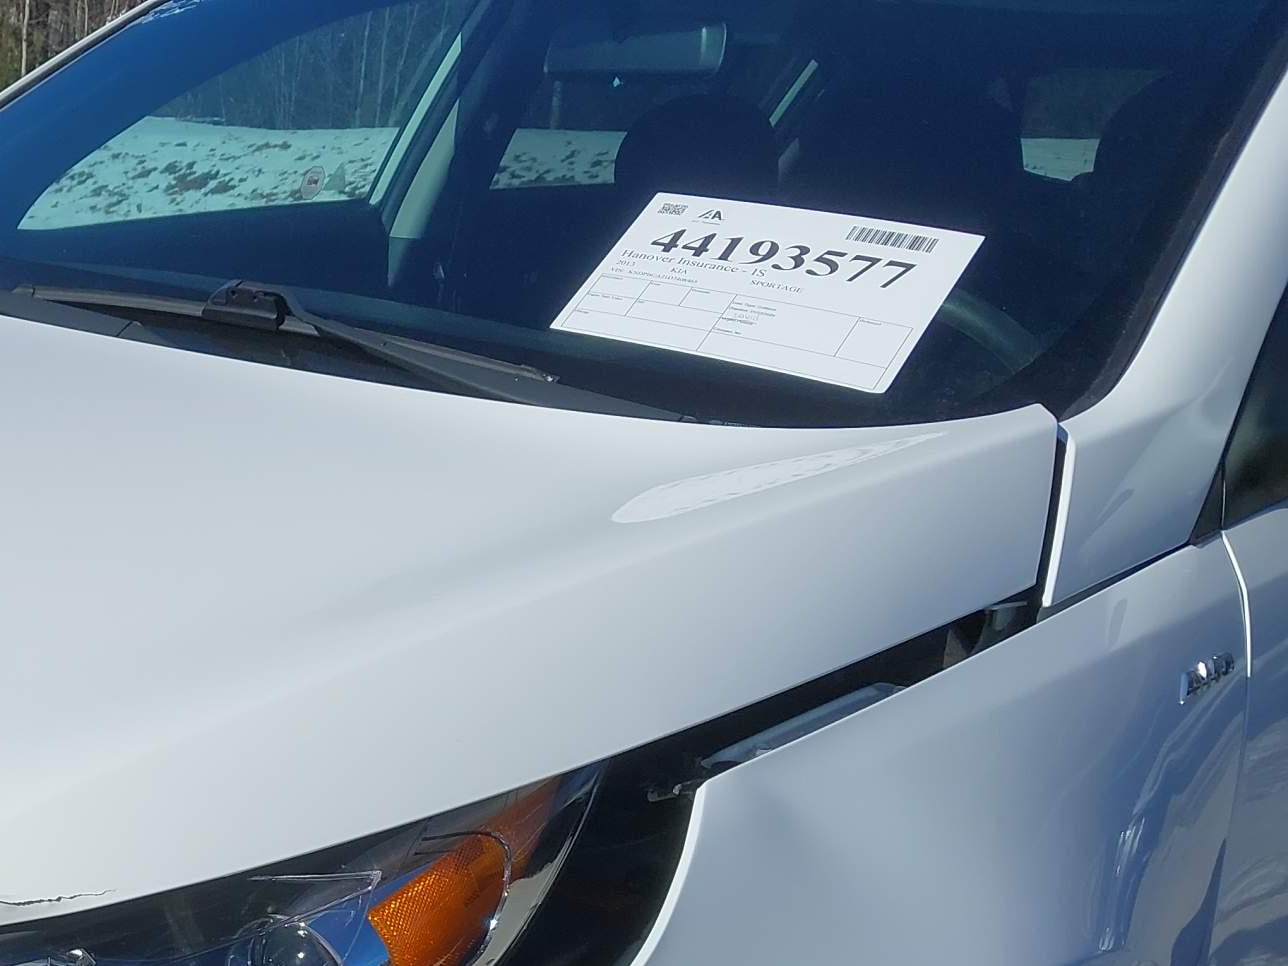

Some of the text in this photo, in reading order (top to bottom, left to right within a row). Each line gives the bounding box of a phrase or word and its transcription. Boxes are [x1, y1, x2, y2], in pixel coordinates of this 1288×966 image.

[621, 249, 675, 264] Hanover
[677, 256, 740, 274] Insurance
[751, 267, 767, 278] IS
[651, 229, 917, 289] 44193577
[669, 266, 688, 275] KIA
[749, 279, 803, 295] SPORTAGE
